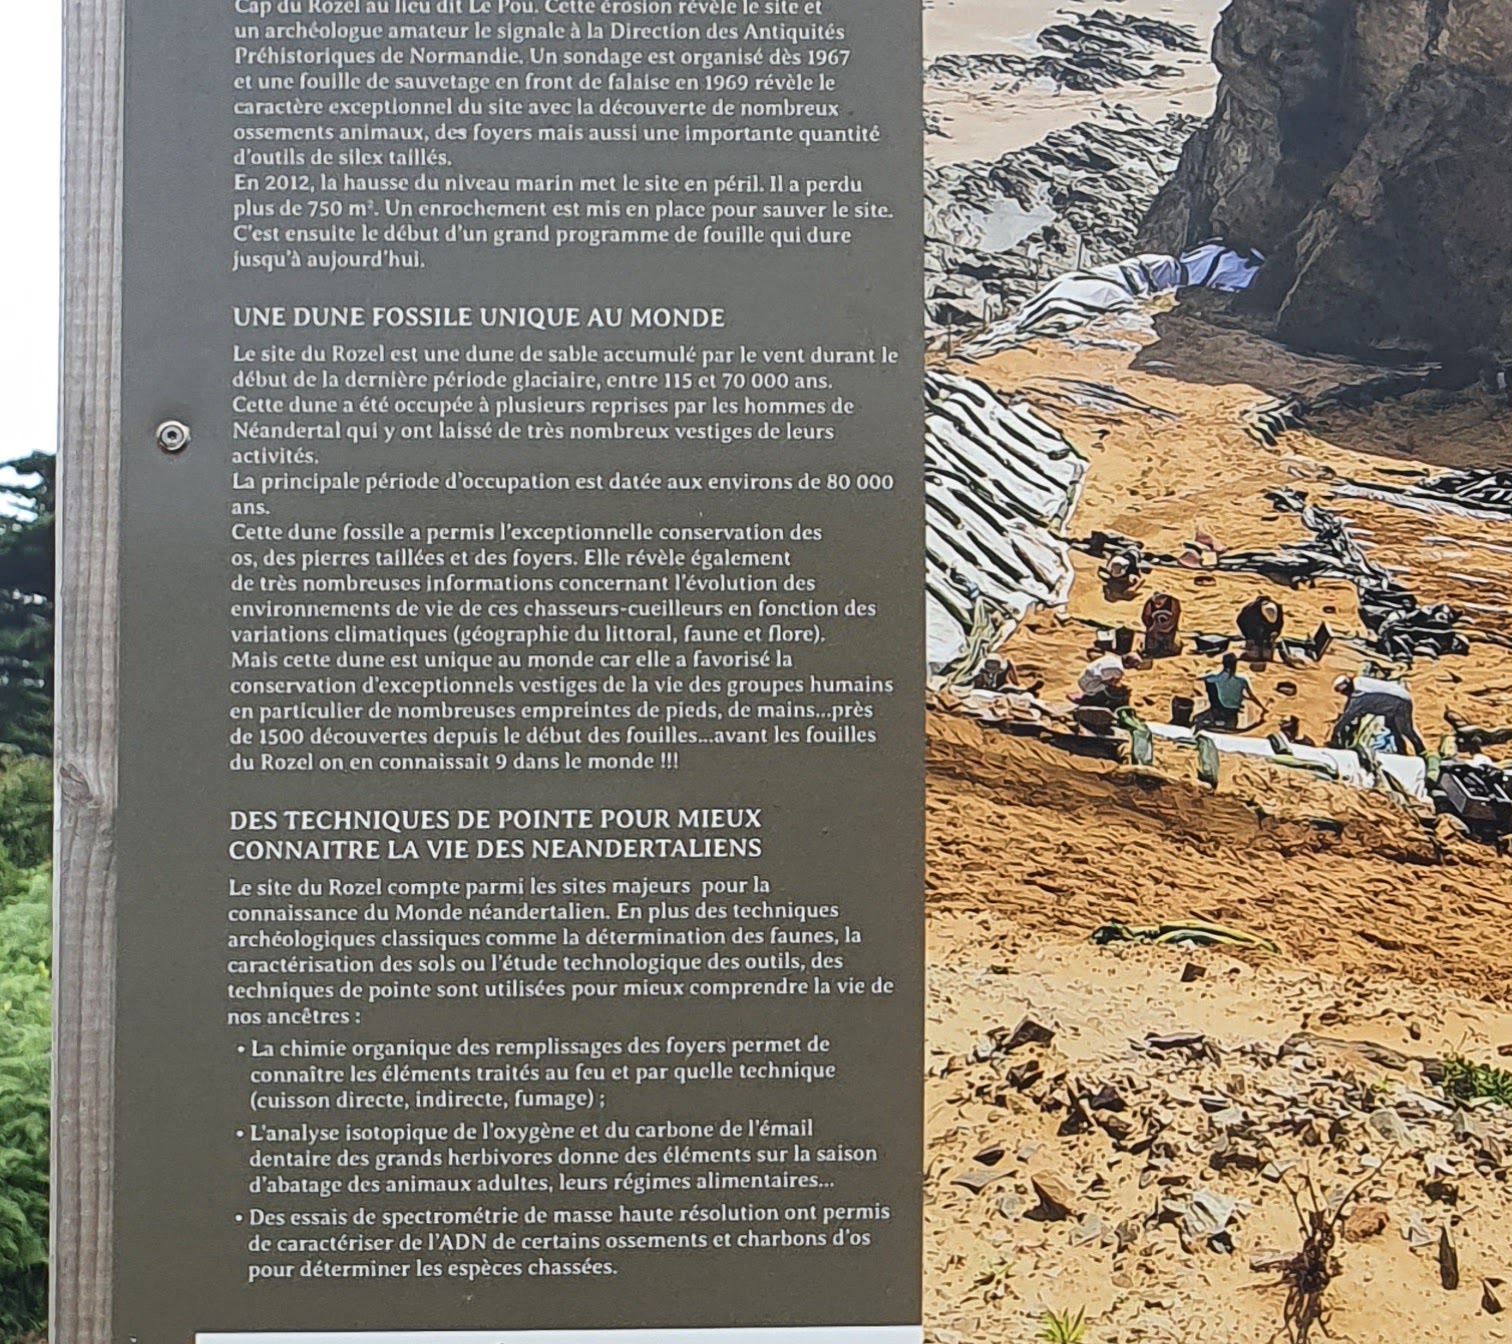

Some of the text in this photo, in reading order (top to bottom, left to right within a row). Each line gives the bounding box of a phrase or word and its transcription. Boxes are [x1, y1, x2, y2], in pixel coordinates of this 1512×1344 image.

[233, 147, 451, 165] d'outils de silex taillés.
[232, 249, 424, 272] jusqu'à aujourd'hui.
[233, 307, 724, 330] UNE DUNE FOSSILE UNIQUE AU MONDE
[231, 446, 319, 464] activités.
[230, 808, 761, 833] DES TECHNIQUES DE POINTE POUR MIEUX
[229, 838, 761, 859] CONNAITRE LA VIE DES NEANDERTALIENS
